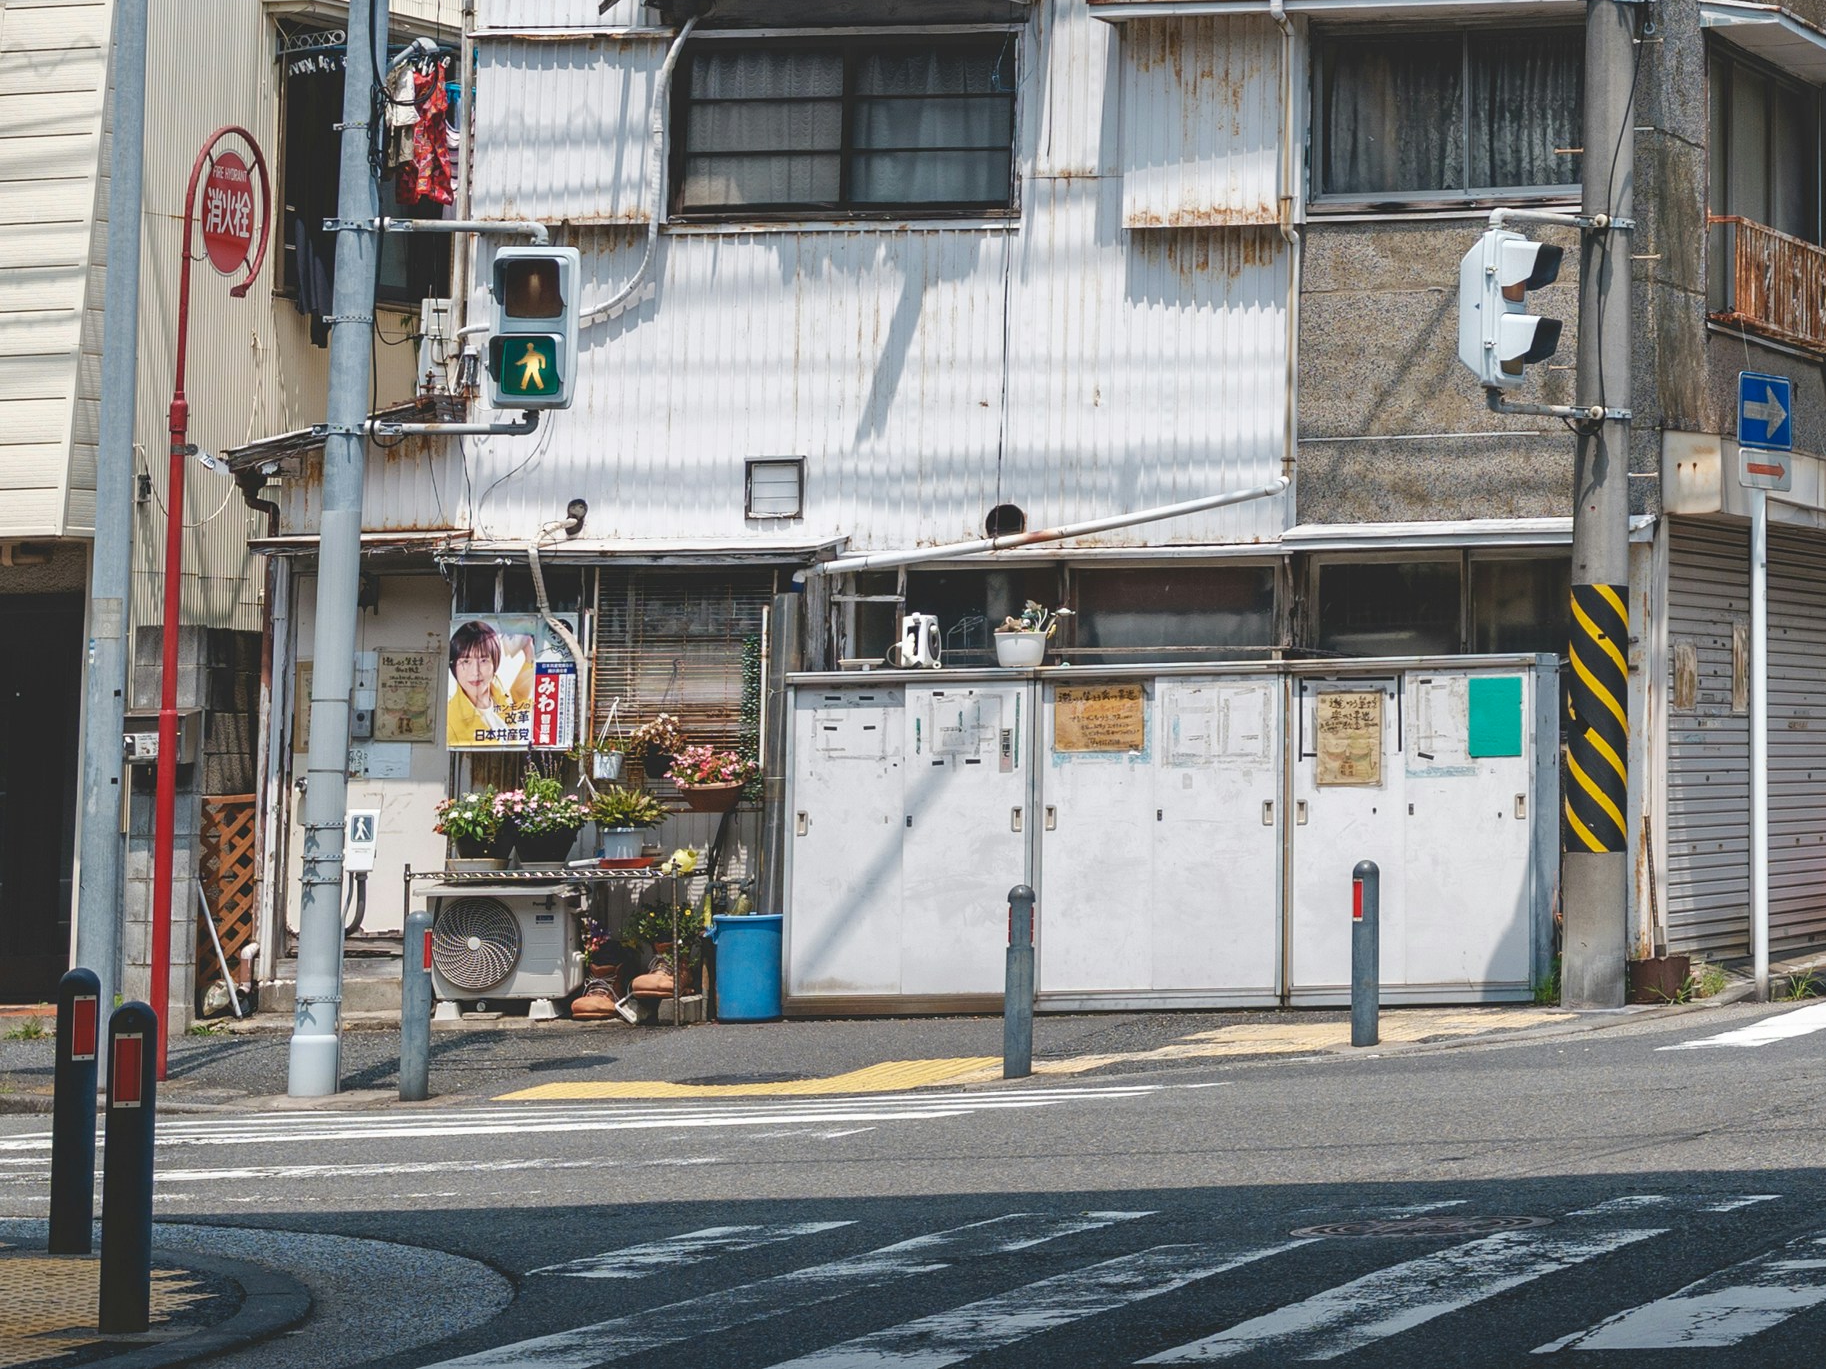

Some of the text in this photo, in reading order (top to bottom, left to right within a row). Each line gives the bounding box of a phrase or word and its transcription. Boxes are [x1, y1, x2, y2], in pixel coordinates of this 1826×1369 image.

[212, 164, 248, 183] FIRE HYDRANT
[206, 187, 251, 238] 消火栓
[505, 711, 530, 725] 改革
[475, 728, 530, 742] 日本共産党
